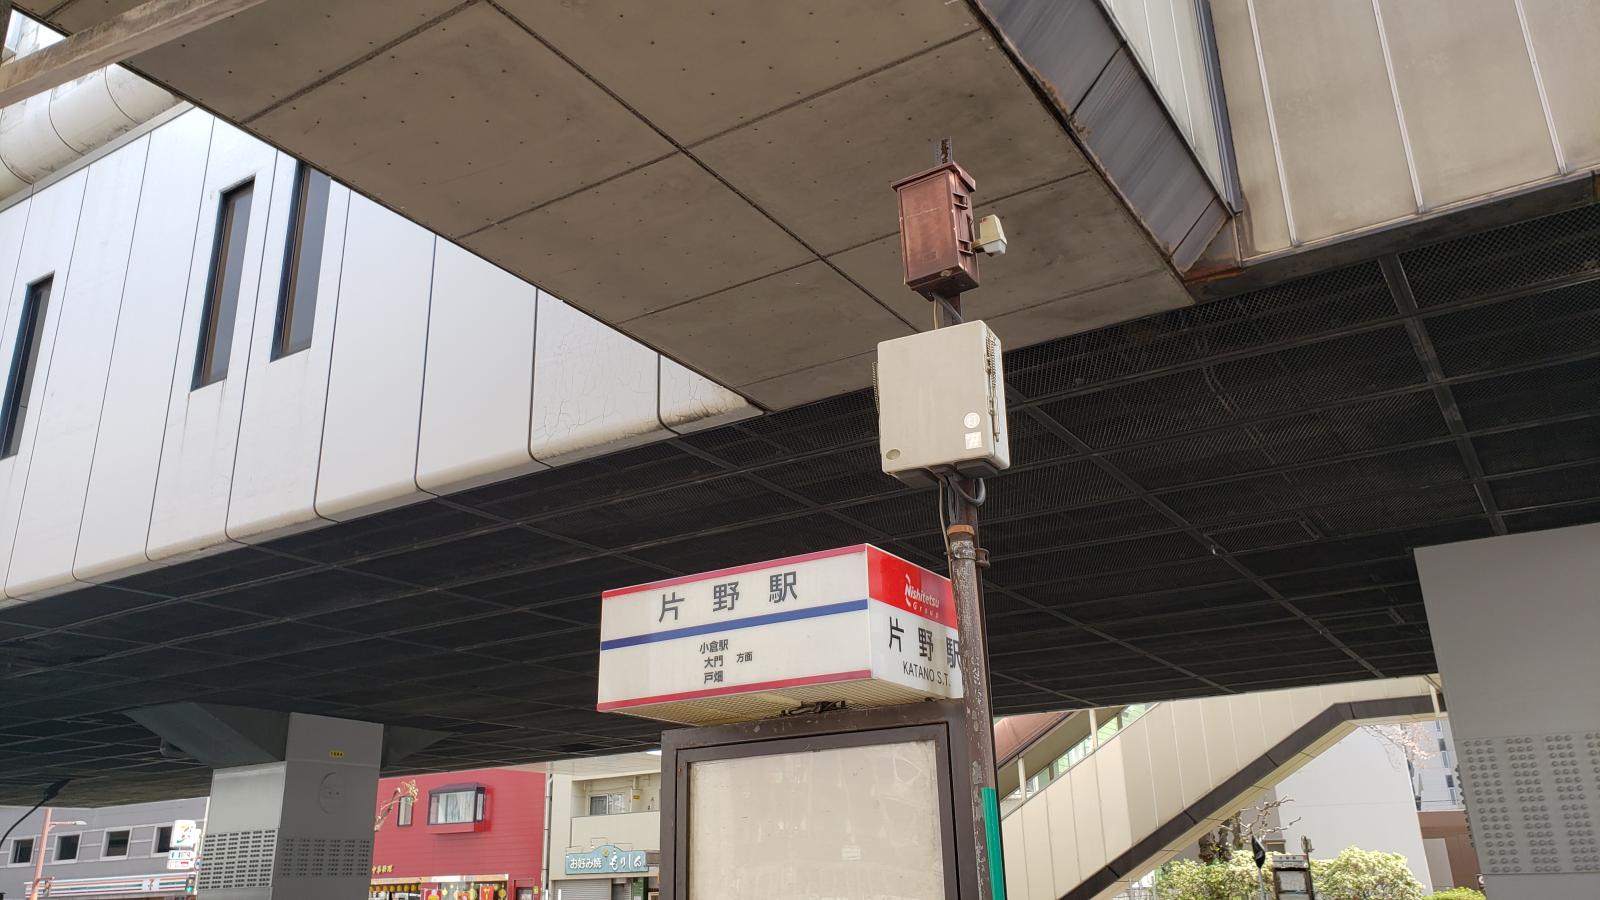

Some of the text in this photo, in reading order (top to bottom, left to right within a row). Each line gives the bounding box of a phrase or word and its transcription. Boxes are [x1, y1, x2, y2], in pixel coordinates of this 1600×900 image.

[658, 571, 797, 623] 片野駅
[904, 582, 940, 608] Nishitetsu
[912, 602, 939, 619] Group
[700, 639, 728, 654] 小倉駅
[704, 651, 752, 668] 大門 方面
[704, 671, 723, 684] 戸畑
[902, 660, 935, 682] KATANO
[569, 857, 602, 869] お好み焼
